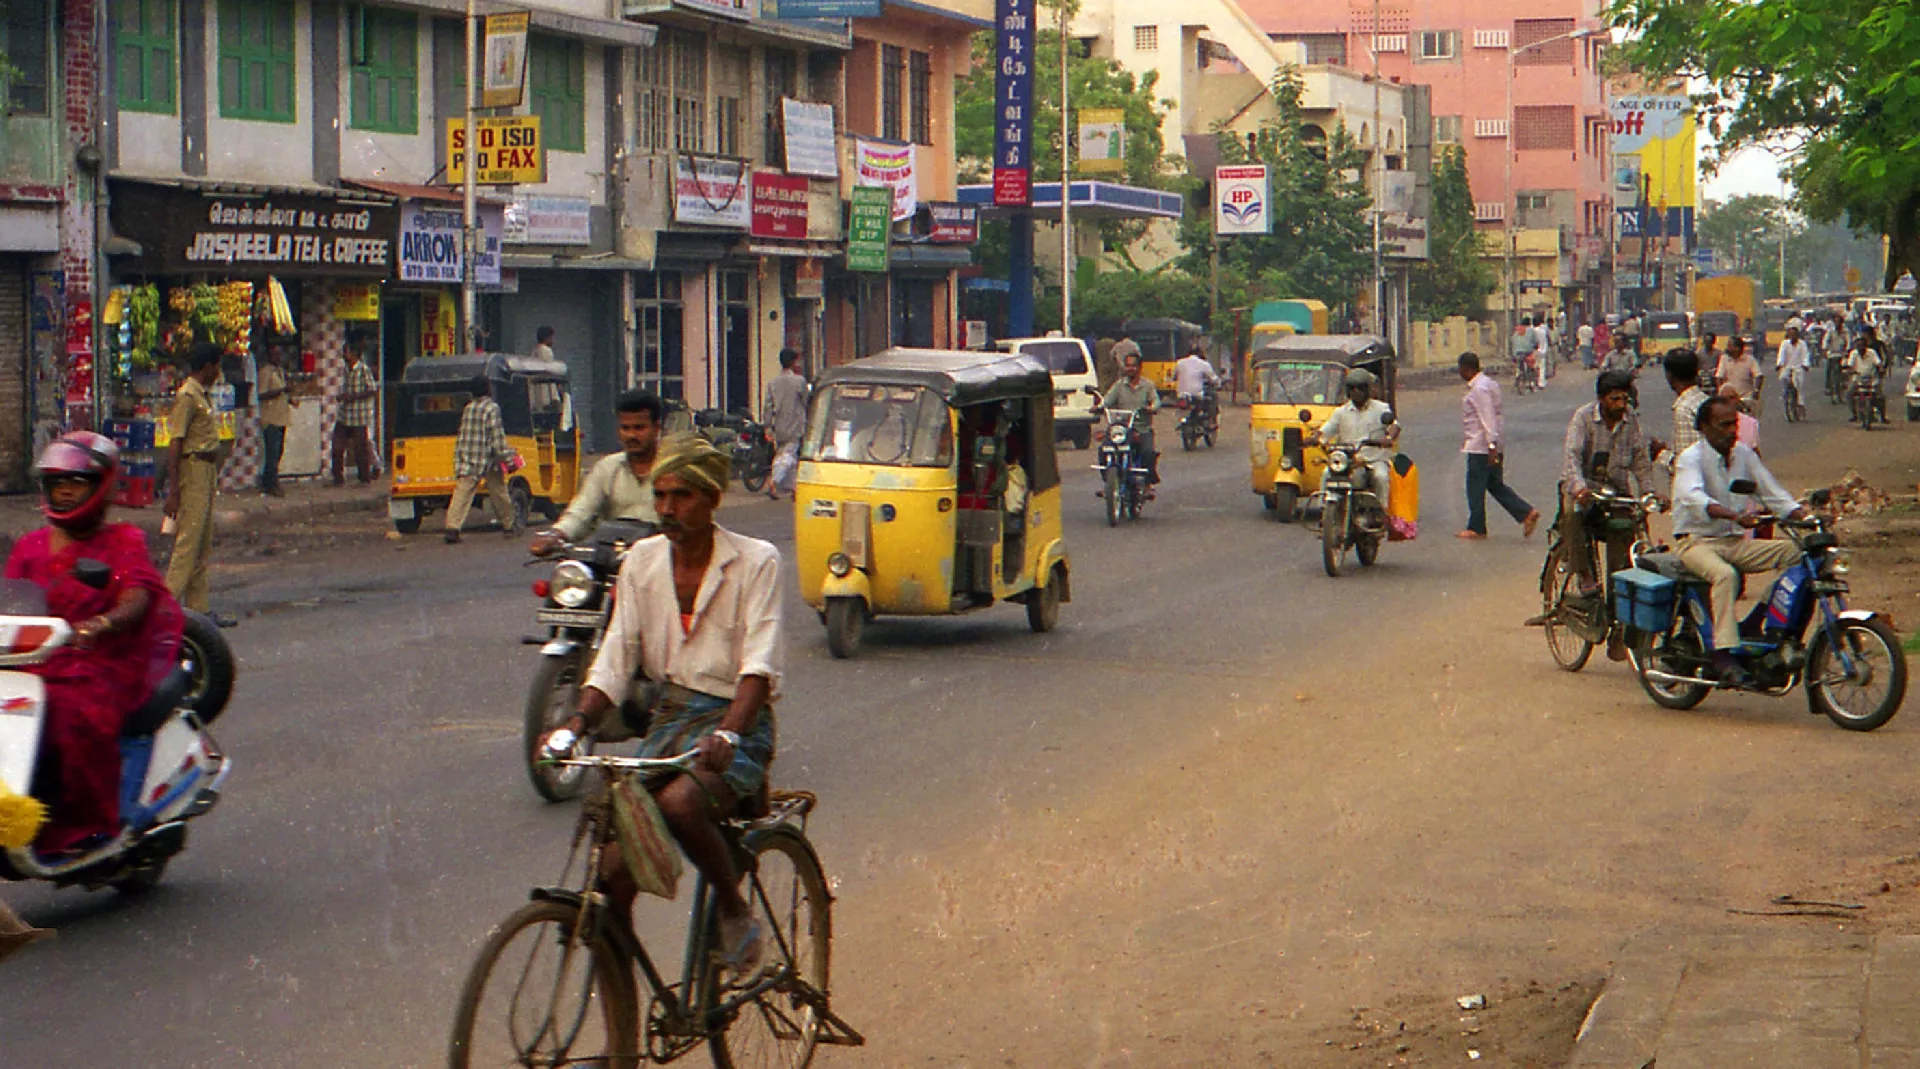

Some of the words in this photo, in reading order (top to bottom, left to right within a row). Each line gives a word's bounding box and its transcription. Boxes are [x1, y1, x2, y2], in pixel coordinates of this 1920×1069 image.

[1611, 111, 1645, 135] off
[452, 128, 494, 148] SD
[502, 127, 536, 147] ISD
[452, 152, 488, 169] PO
[497, 149, 536, 169] FAX
[1232, 190, 1253, 202] HP
[186, 233, 291, 261] JASHEELA
[294, 236, 320, 261] TEA
[334, 237, 389, 264] COFFEE
